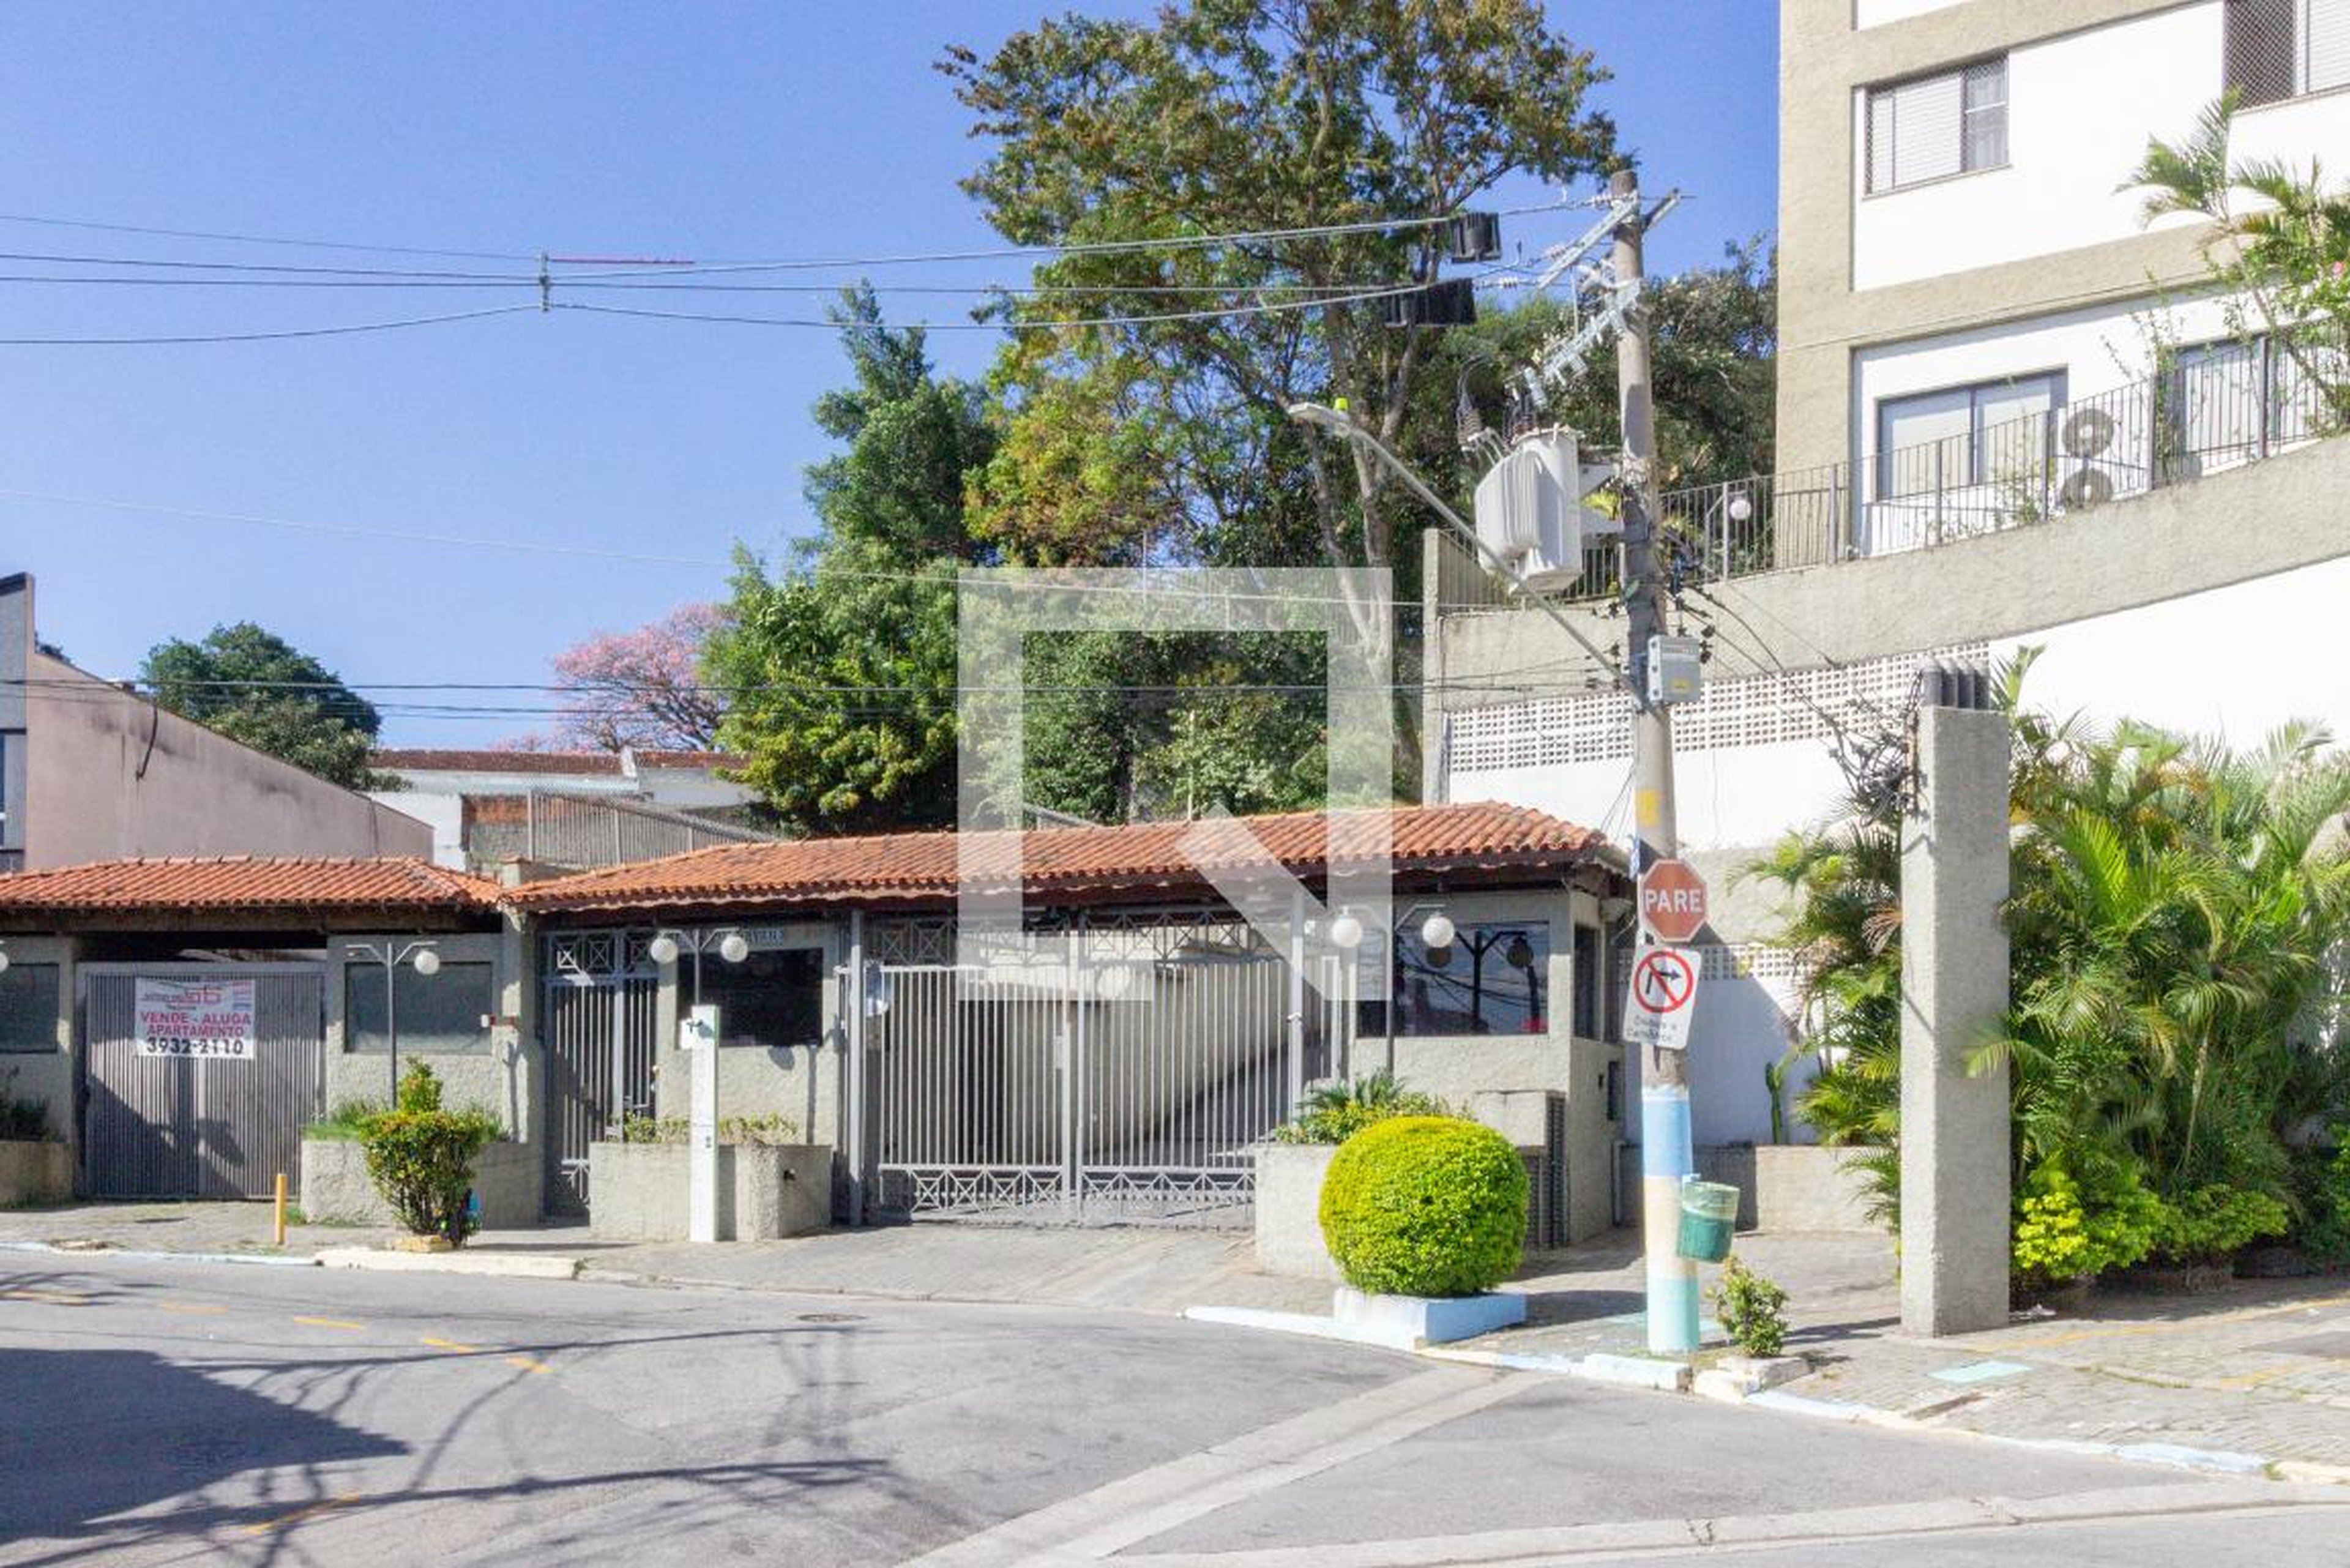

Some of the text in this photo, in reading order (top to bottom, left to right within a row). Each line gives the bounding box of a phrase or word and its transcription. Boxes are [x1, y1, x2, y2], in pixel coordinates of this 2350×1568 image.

[1645, 889, 1703, 914] PARE
[141, 1012, 188, 1023] VENDE
[202, 1013, 252, 1025] ALUGA
[146, 1025, 244, 1037] APARTAMENTO
[147, 1037, 244, 1055] 3932-2110
